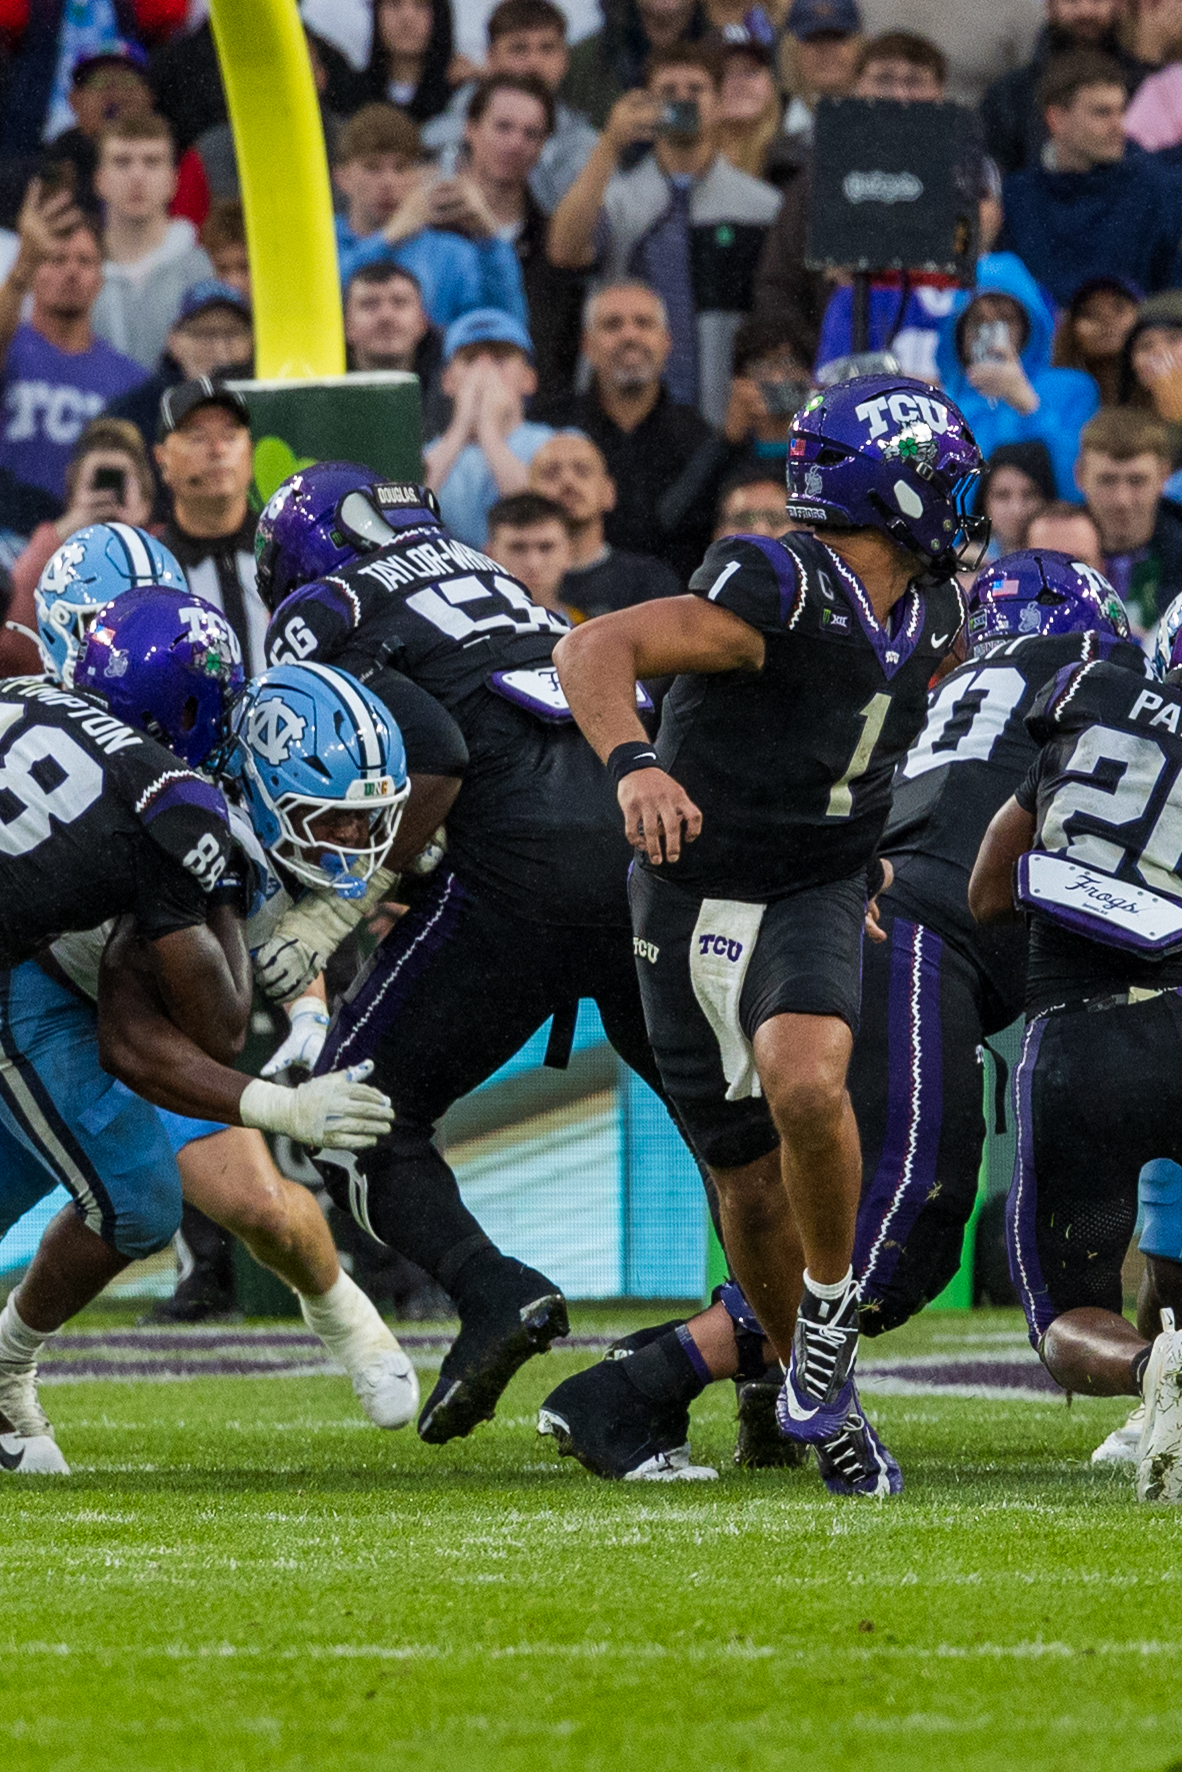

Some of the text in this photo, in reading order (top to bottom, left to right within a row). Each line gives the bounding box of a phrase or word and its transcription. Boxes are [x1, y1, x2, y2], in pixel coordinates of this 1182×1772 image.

[855, 394, 949, 440] TCU
[708, 560, 742, 601] 1
[178, 606, 243, 665] TCU
[895, 667, 1026, 779] 0
[826, 692, 892, 817] 1
[0, 703, 103, 857] 8
[1065, 874, 1143, 915] Frogs
[632, 936, 660, 964] TCU
[699, 934, 744, 963] TCU
